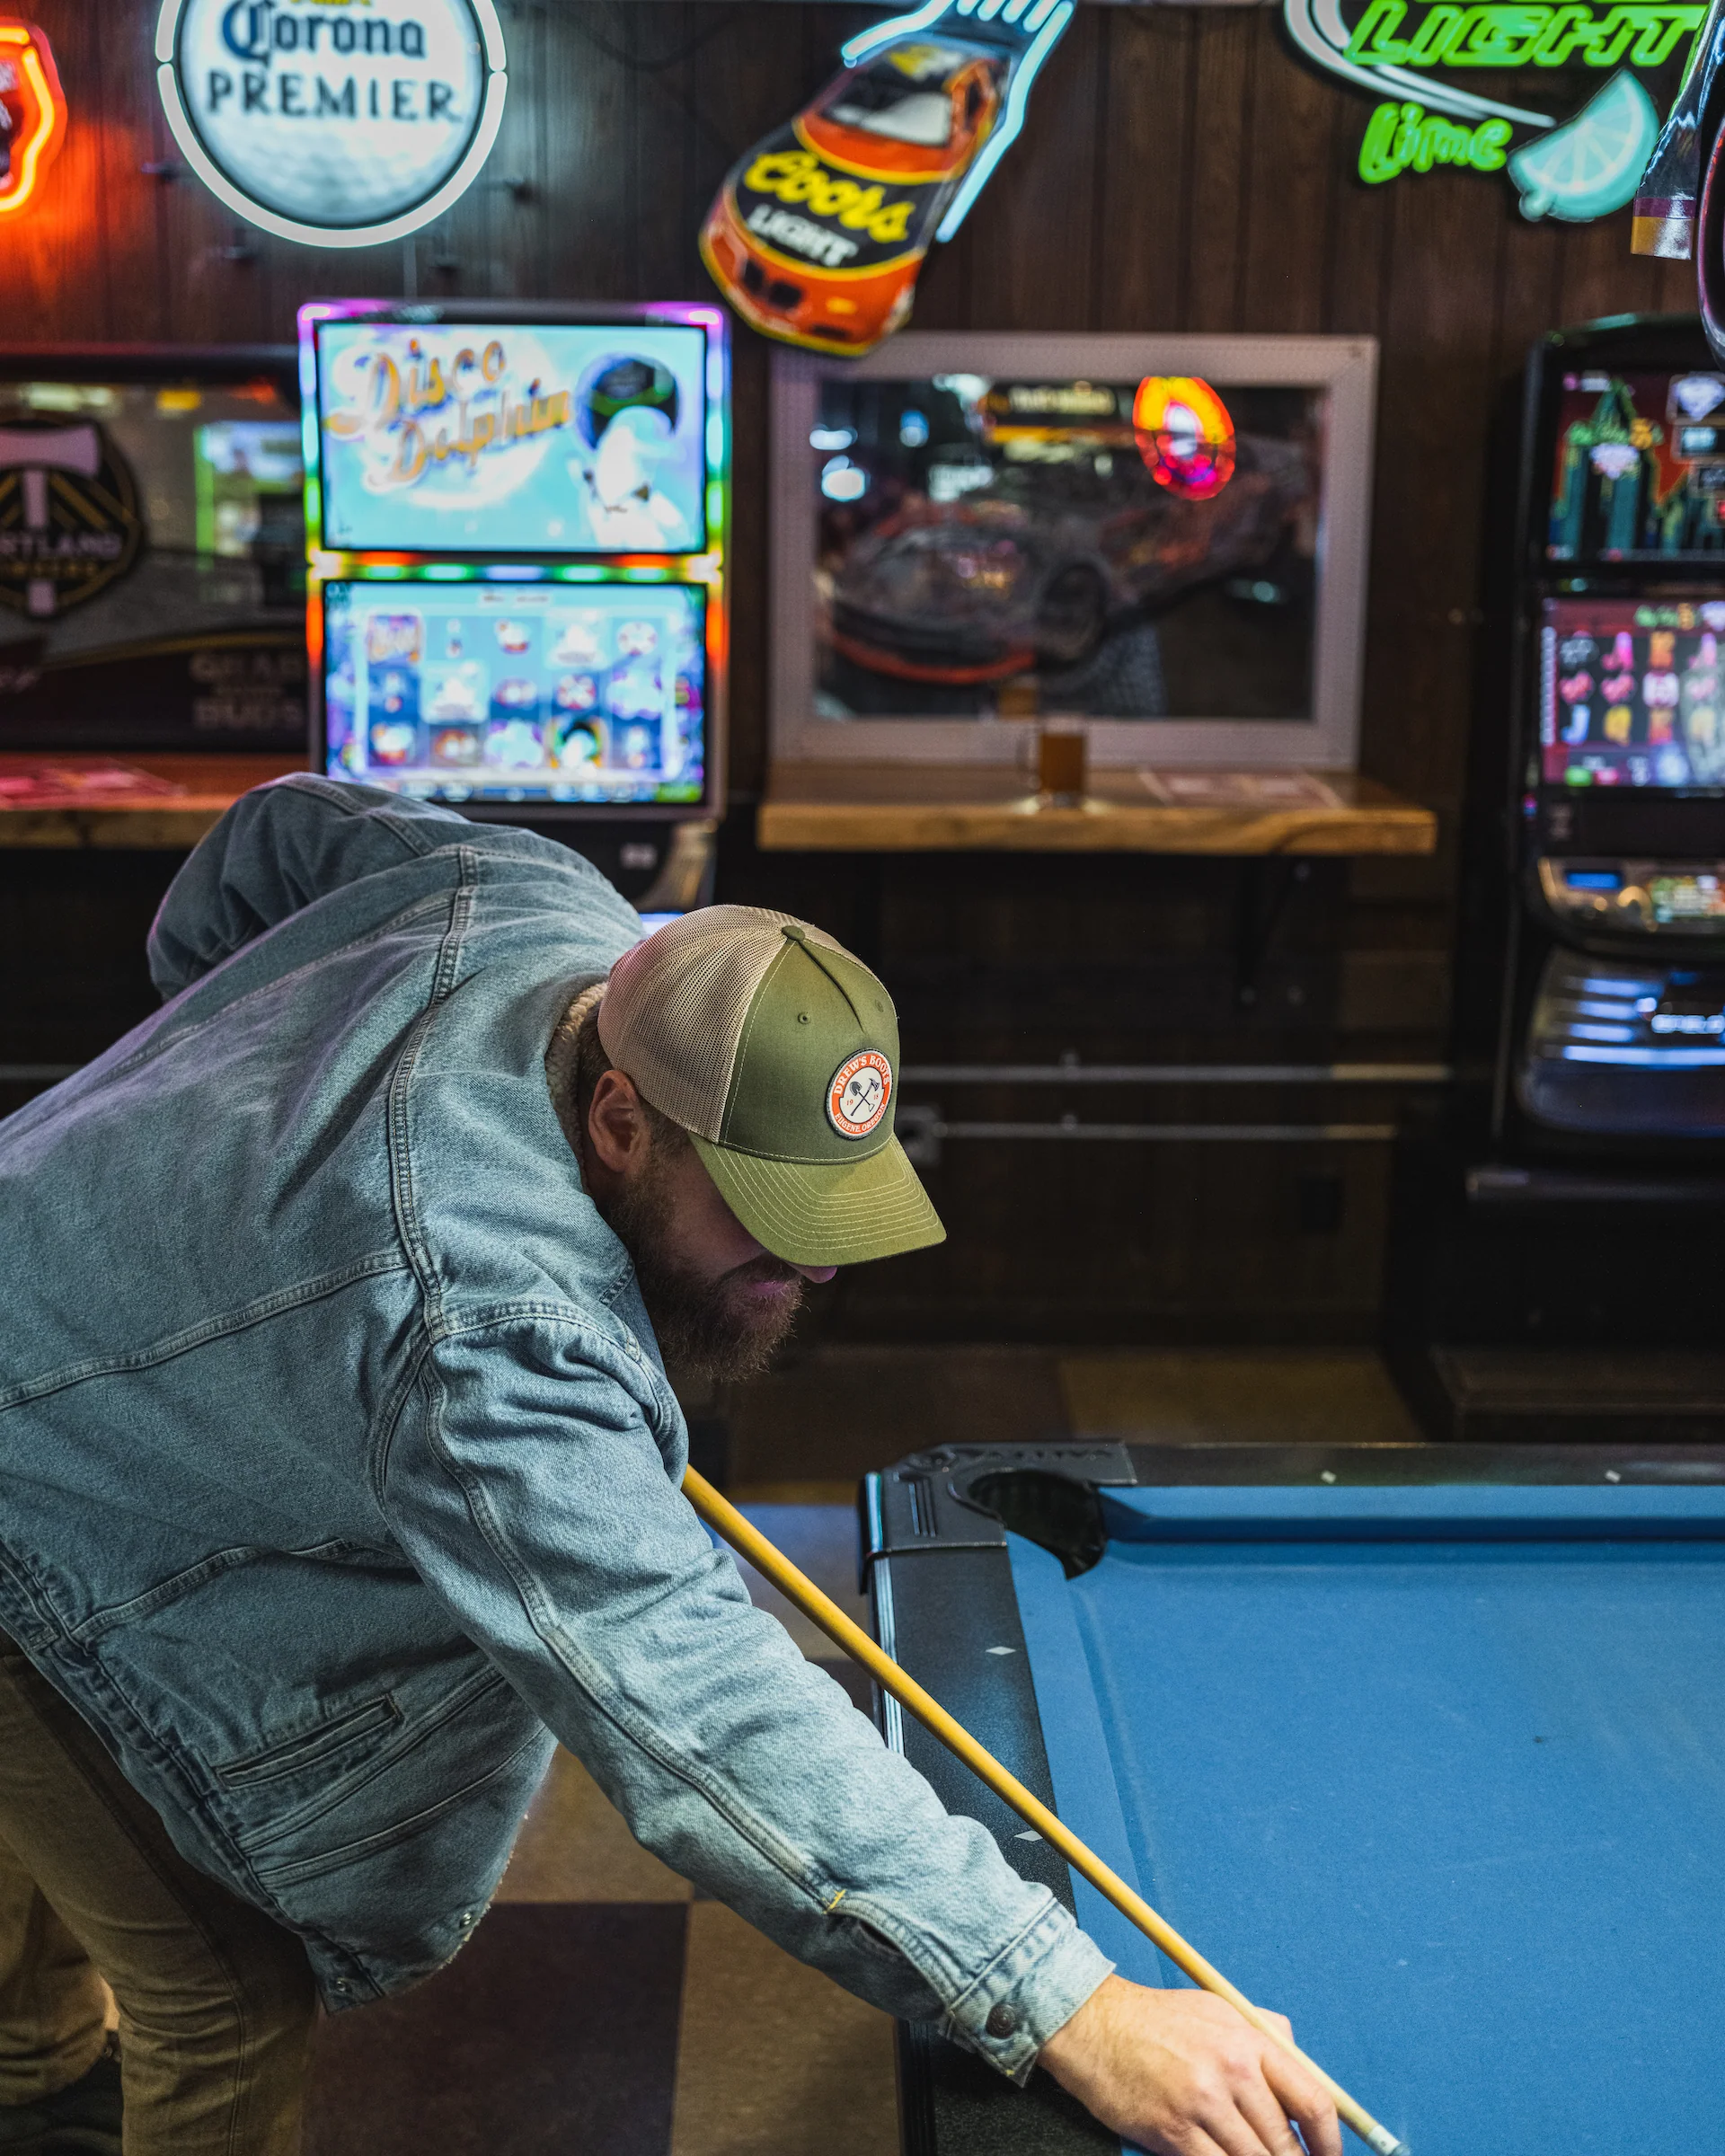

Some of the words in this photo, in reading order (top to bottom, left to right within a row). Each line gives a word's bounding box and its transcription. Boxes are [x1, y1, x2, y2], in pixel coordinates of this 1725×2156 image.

[221, 0, 428, 68] Corona
[1344, 0, 1709, 66] LIGHT
[208, 69, 464, 123] PREMIER
[1358, 101, 1513, 184] Lime
[744, 151, 916, 243] Coors
[746, 203, 858, 268] LIGHT
[323, 337, 507, 435] Disco
[833, 1056, 868, 1095] DREW'S
[869, 1055, 891, 1085] BOOTS
[834, 1111, 862, 1133] EUGENE
[861, 1102, 886, 1131] OREGON
